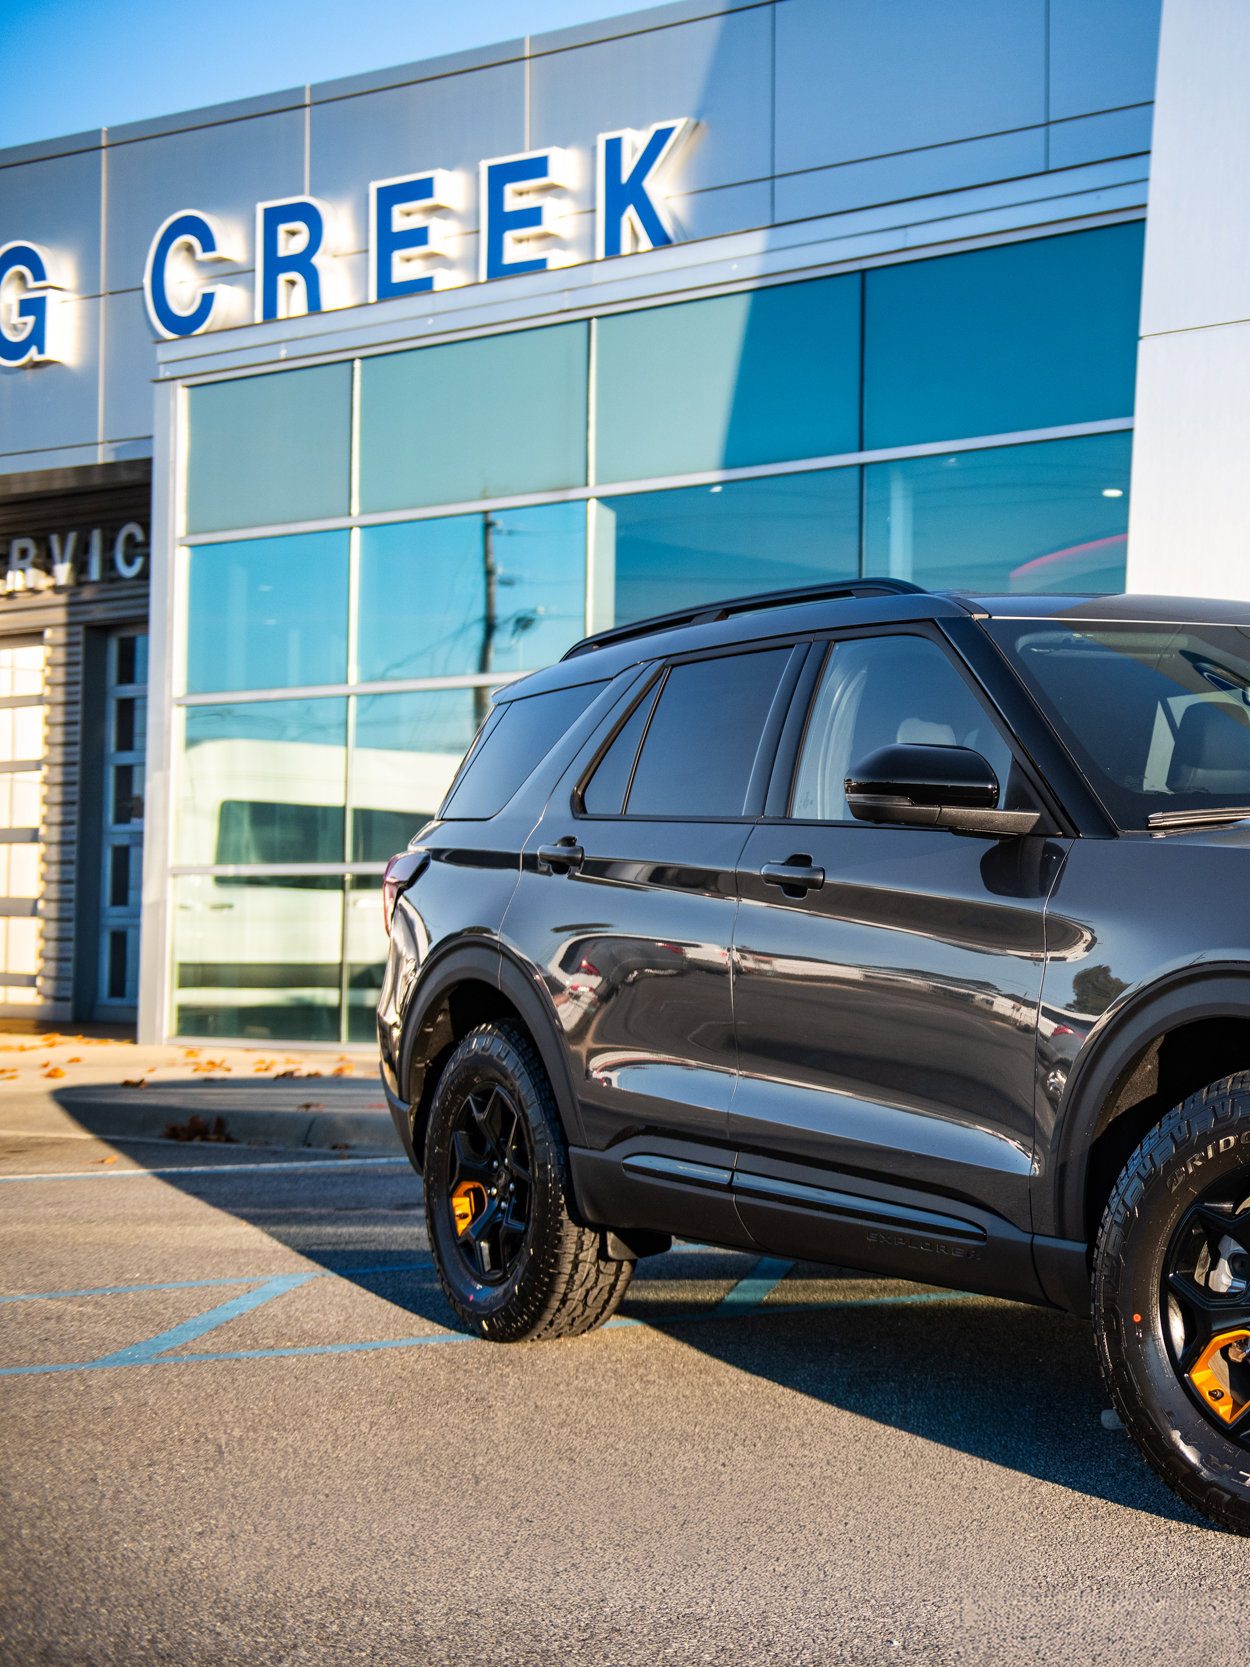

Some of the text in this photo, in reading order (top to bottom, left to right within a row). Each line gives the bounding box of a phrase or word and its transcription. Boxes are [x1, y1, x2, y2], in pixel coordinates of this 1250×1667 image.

[143, 117, 692, 339] CREEK
[2, 521, 146, 594] RVIC
[866, 1231, 982, 1260] EXPLORER
